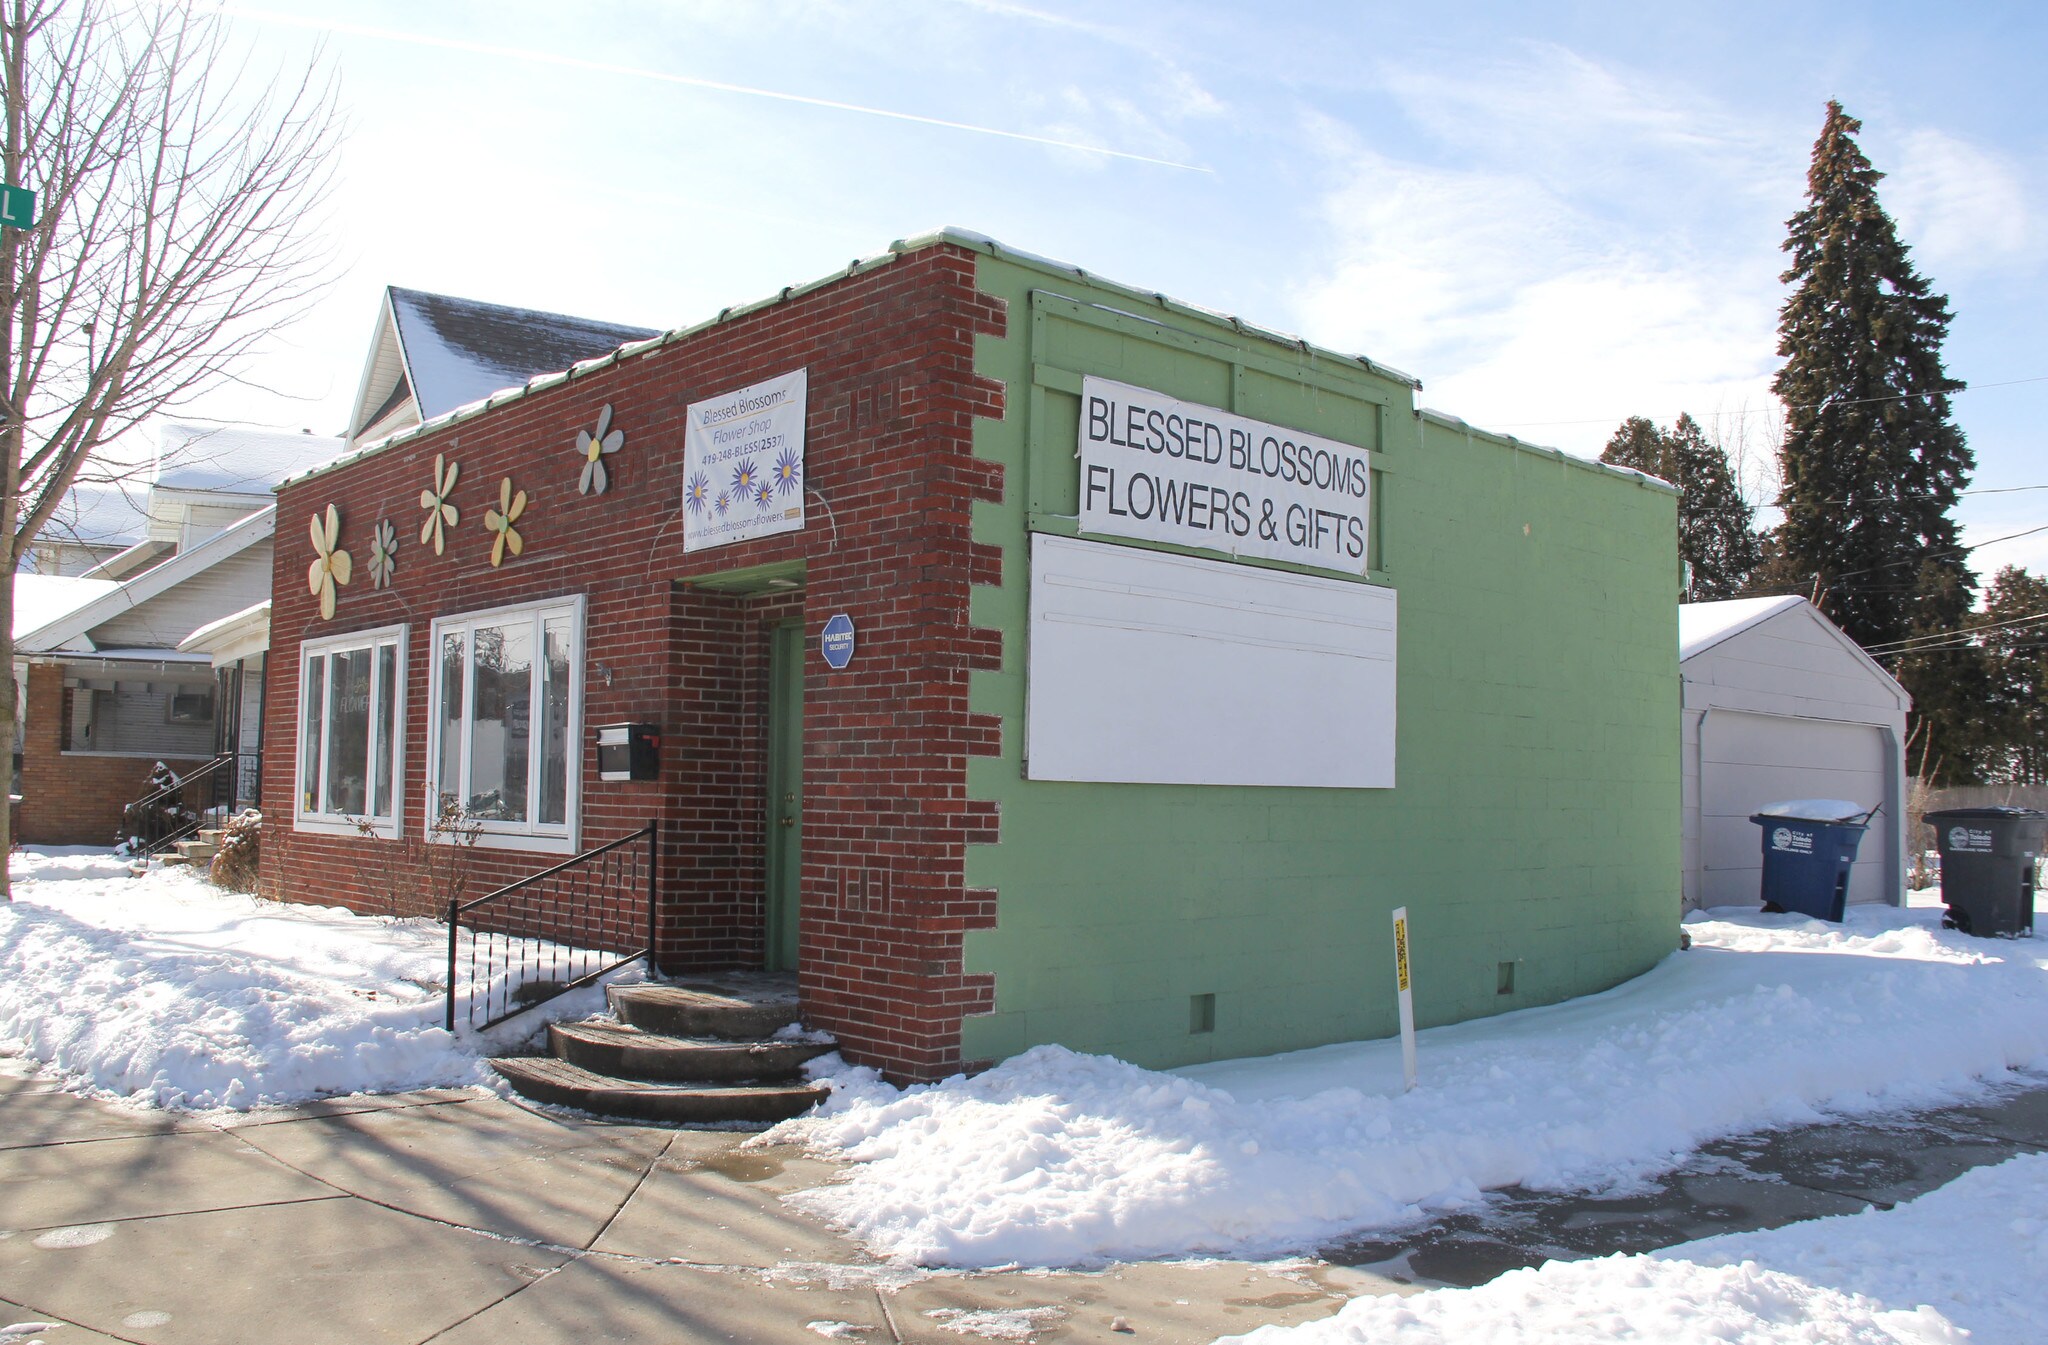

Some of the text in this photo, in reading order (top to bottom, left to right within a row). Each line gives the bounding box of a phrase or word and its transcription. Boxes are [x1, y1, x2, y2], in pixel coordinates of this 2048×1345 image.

[703, 389, 787, 425] Blessed Blossoms
[713, 418, 772, 445] Flower Shop
[1088, 396, 1366, 498] BLESSED BLOSSOMS
[701, 433, 785, 466] 419-248-BLESS(2537)
[1086, 464, 1364, 558] FLOWERS & GIFTS
[824, 632, 852, 643] HABITEC
[829, 643, 849, 651] SECURITY
